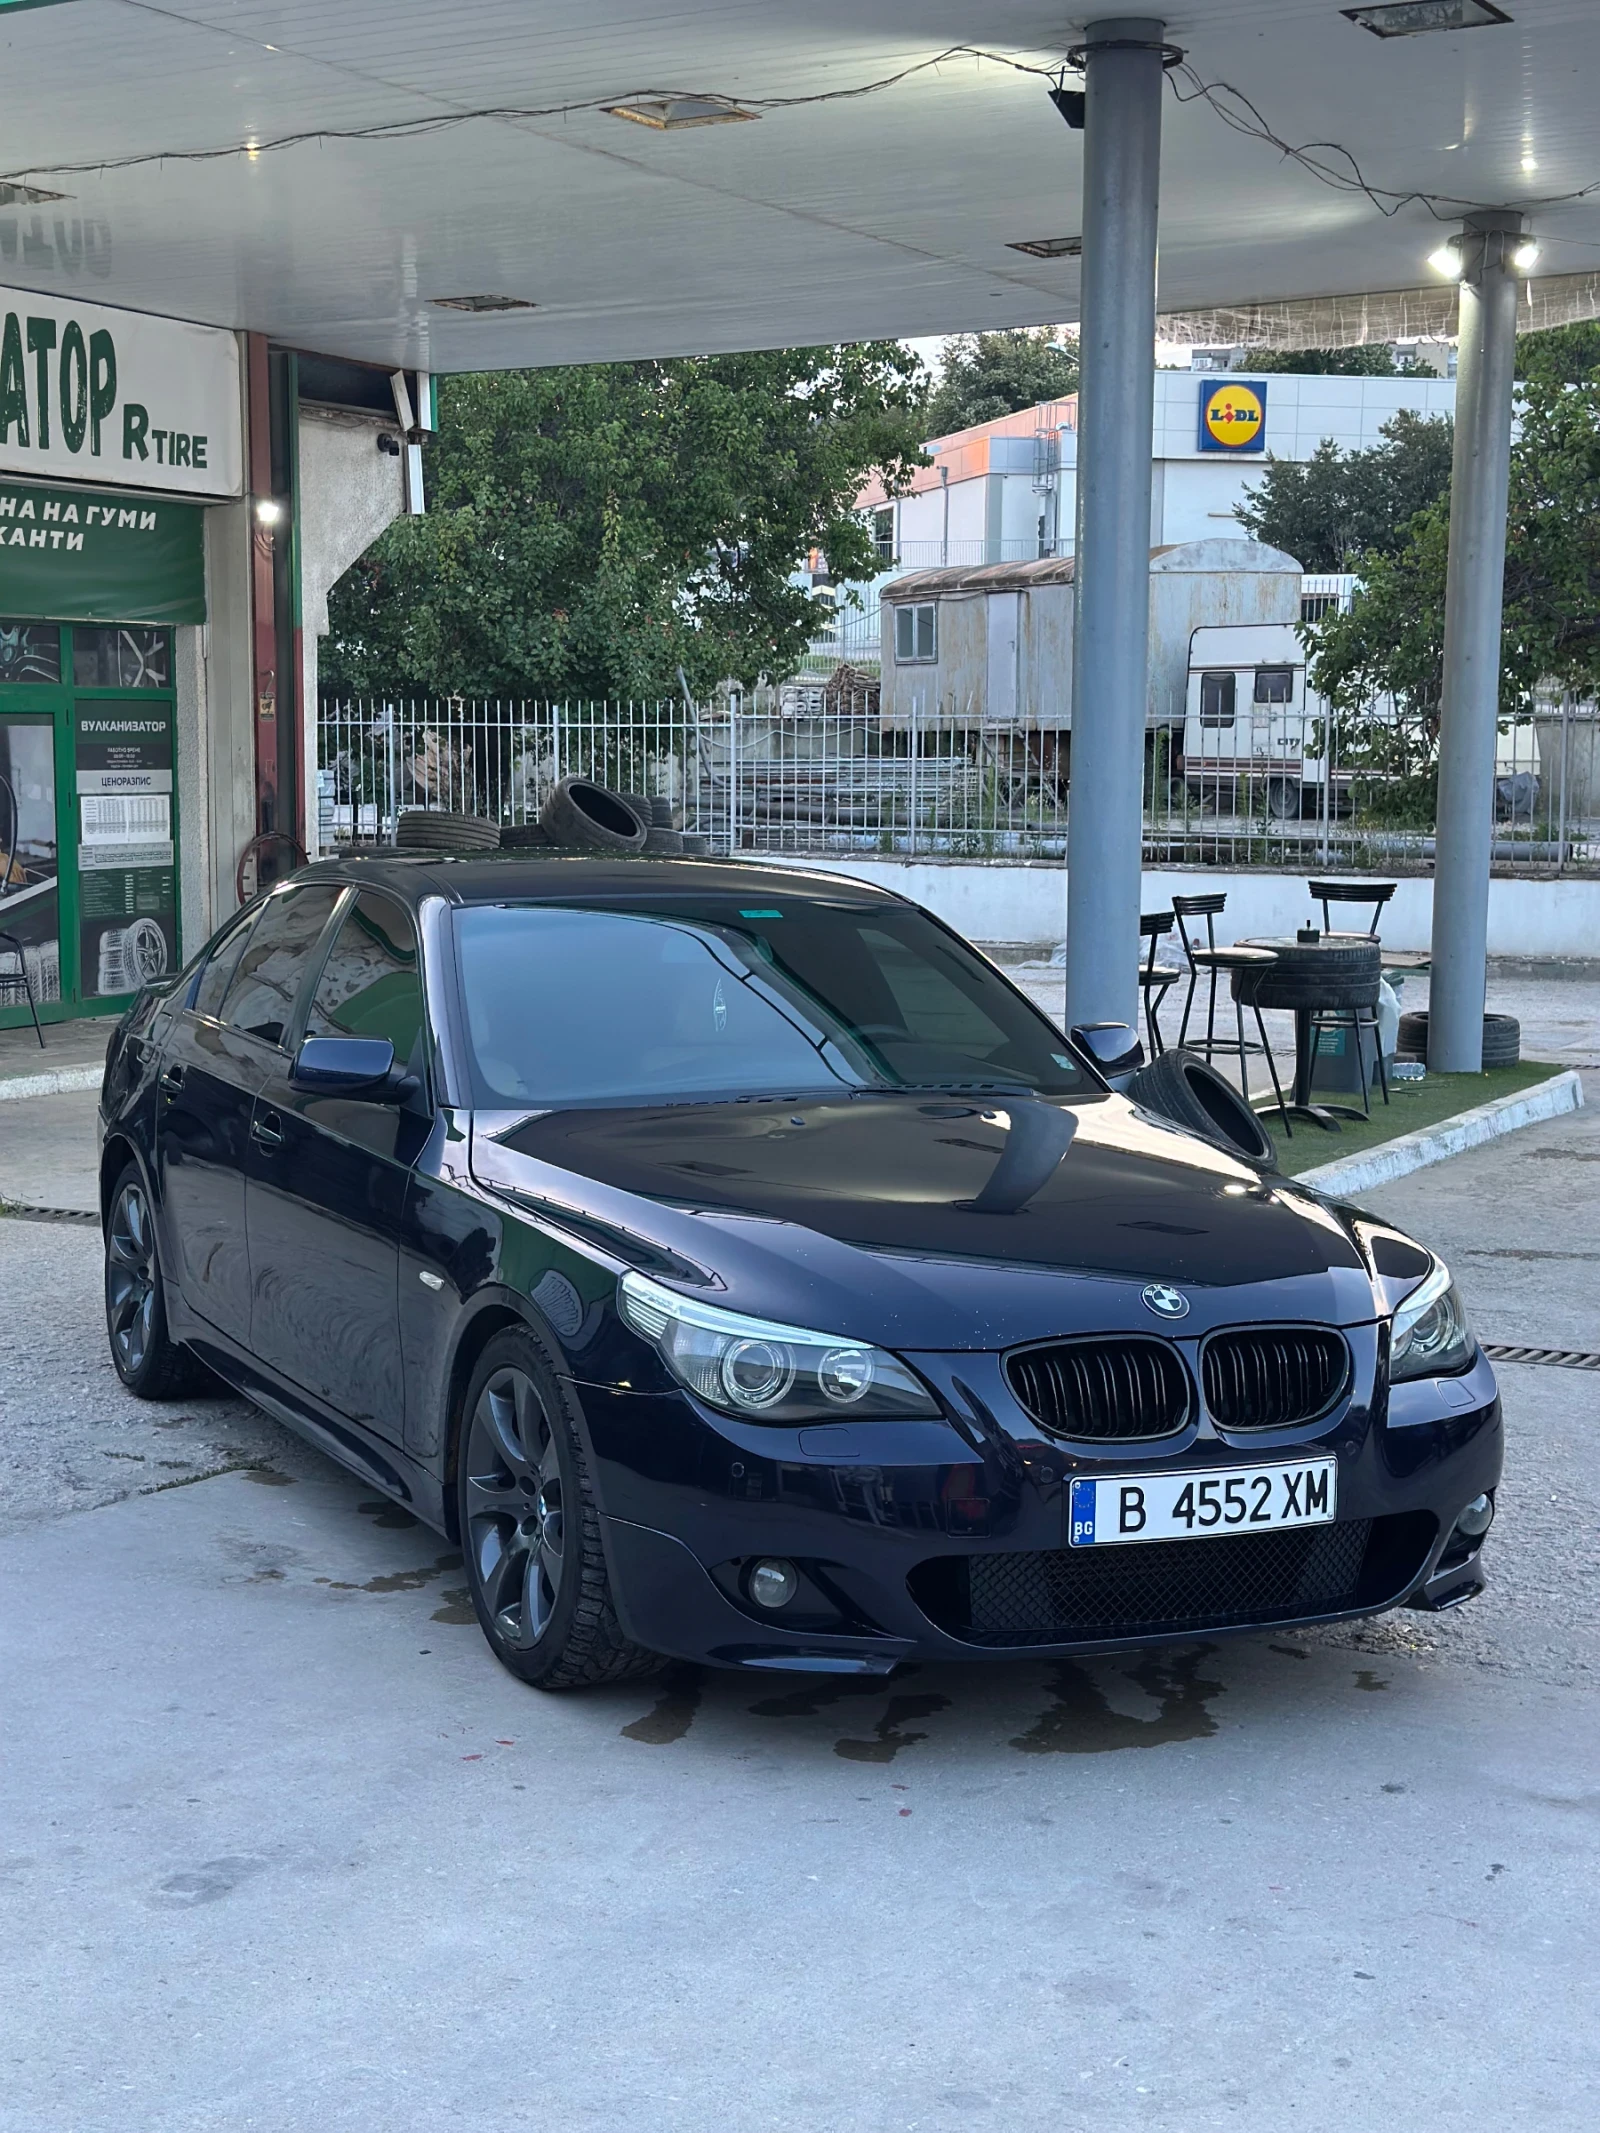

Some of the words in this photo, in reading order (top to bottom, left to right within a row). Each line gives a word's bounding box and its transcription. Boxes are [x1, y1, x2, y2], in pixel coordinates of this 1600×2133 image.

[43, 502, 79, 523] НА
[86, 506, 156, 530] ГУМИ
[81, 721, 166, 732] ВУЛКАНИЗАТОР
[101, 777, 151, 787] ЦЕНОРАЗПИС
[1119, 1486, 1147, 1534] B
[1172, 1476, 1272, 1528] 4552
[1281, 1468, 1329, 1519] XM
[1074, 1521, 1093, 1535] BG
